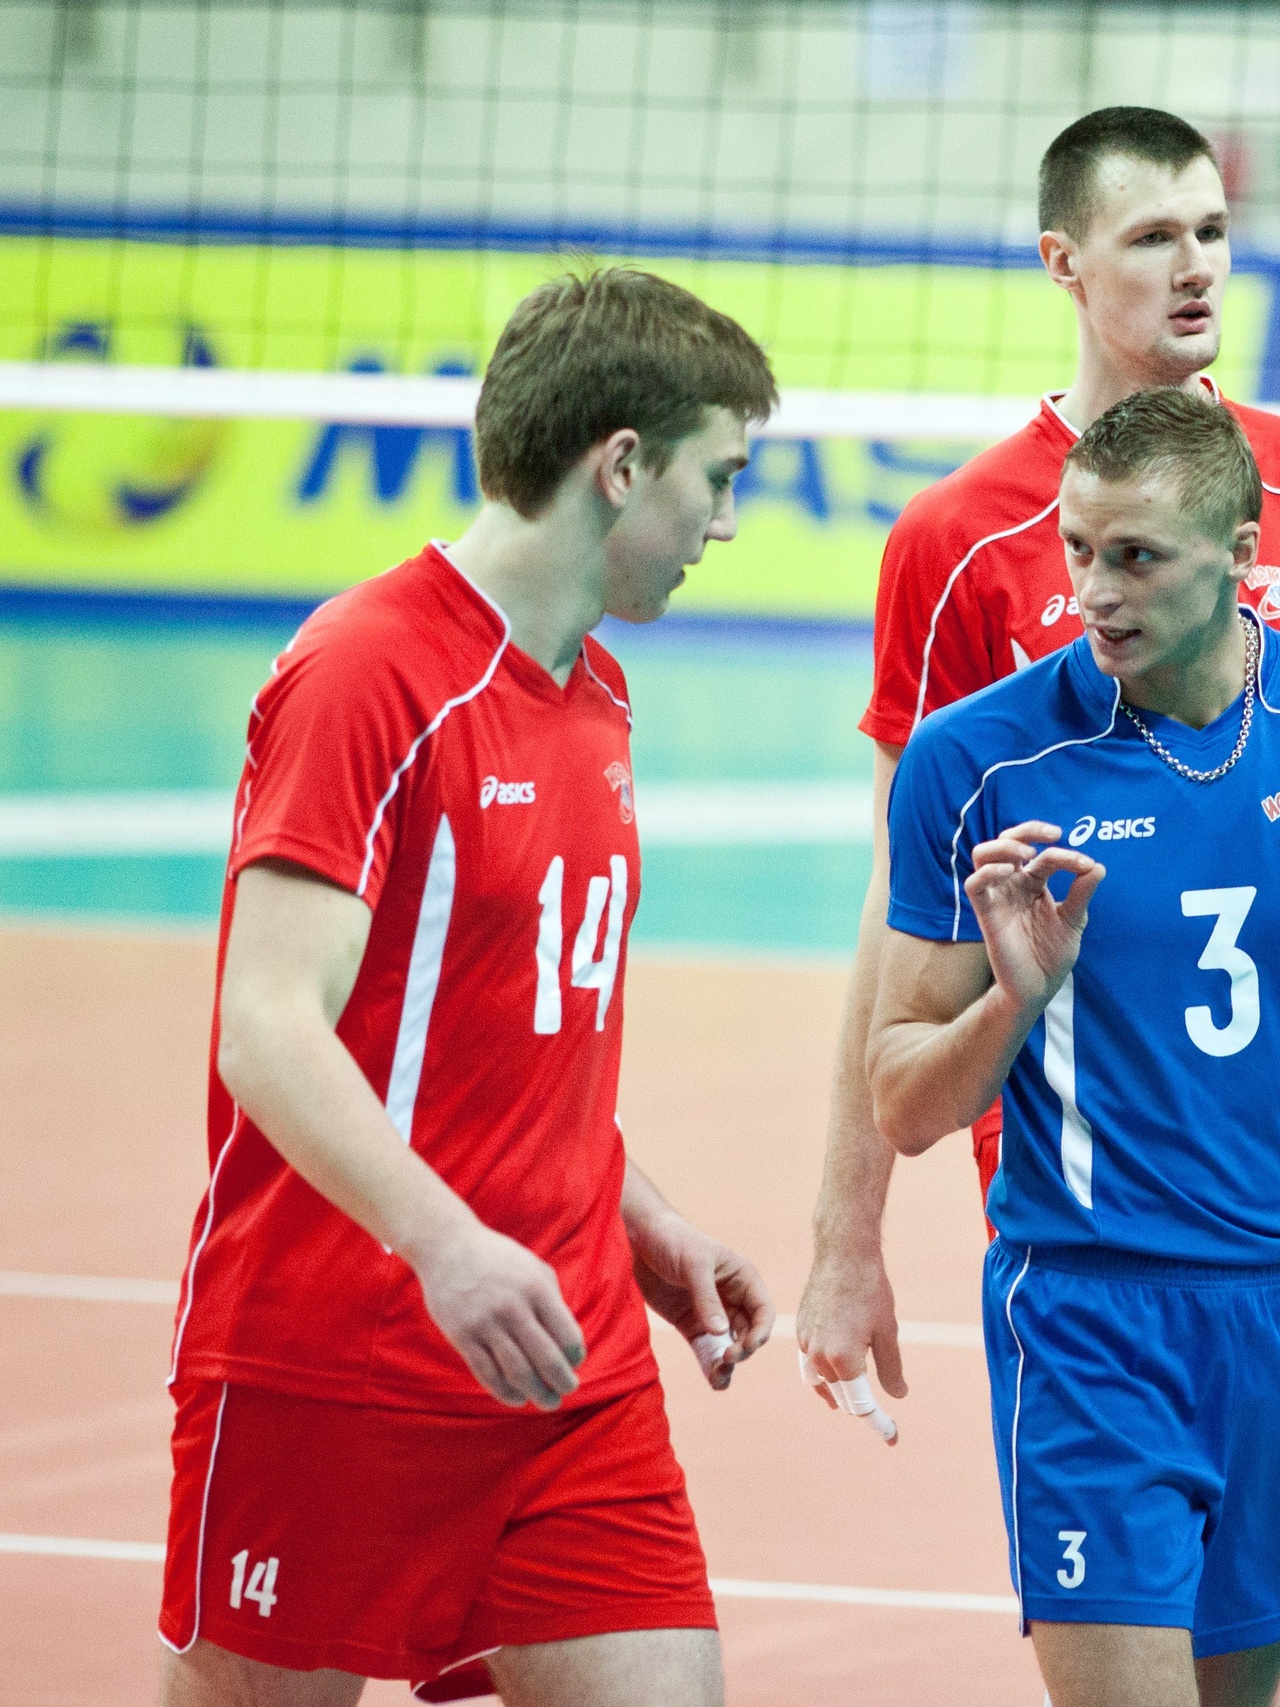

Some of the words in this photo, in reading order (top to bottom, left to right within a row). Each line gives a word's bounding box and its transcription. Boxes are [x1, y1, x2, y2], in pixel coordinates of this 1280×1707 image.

[1097, 816, 1157, 841] asics
[534, 855, 628, 1035] 14
[1180, 885, 1261, 1058] 3
[229, 1548, 280, 1618] 14
[1056, 1530, 1088, 1590] 3
